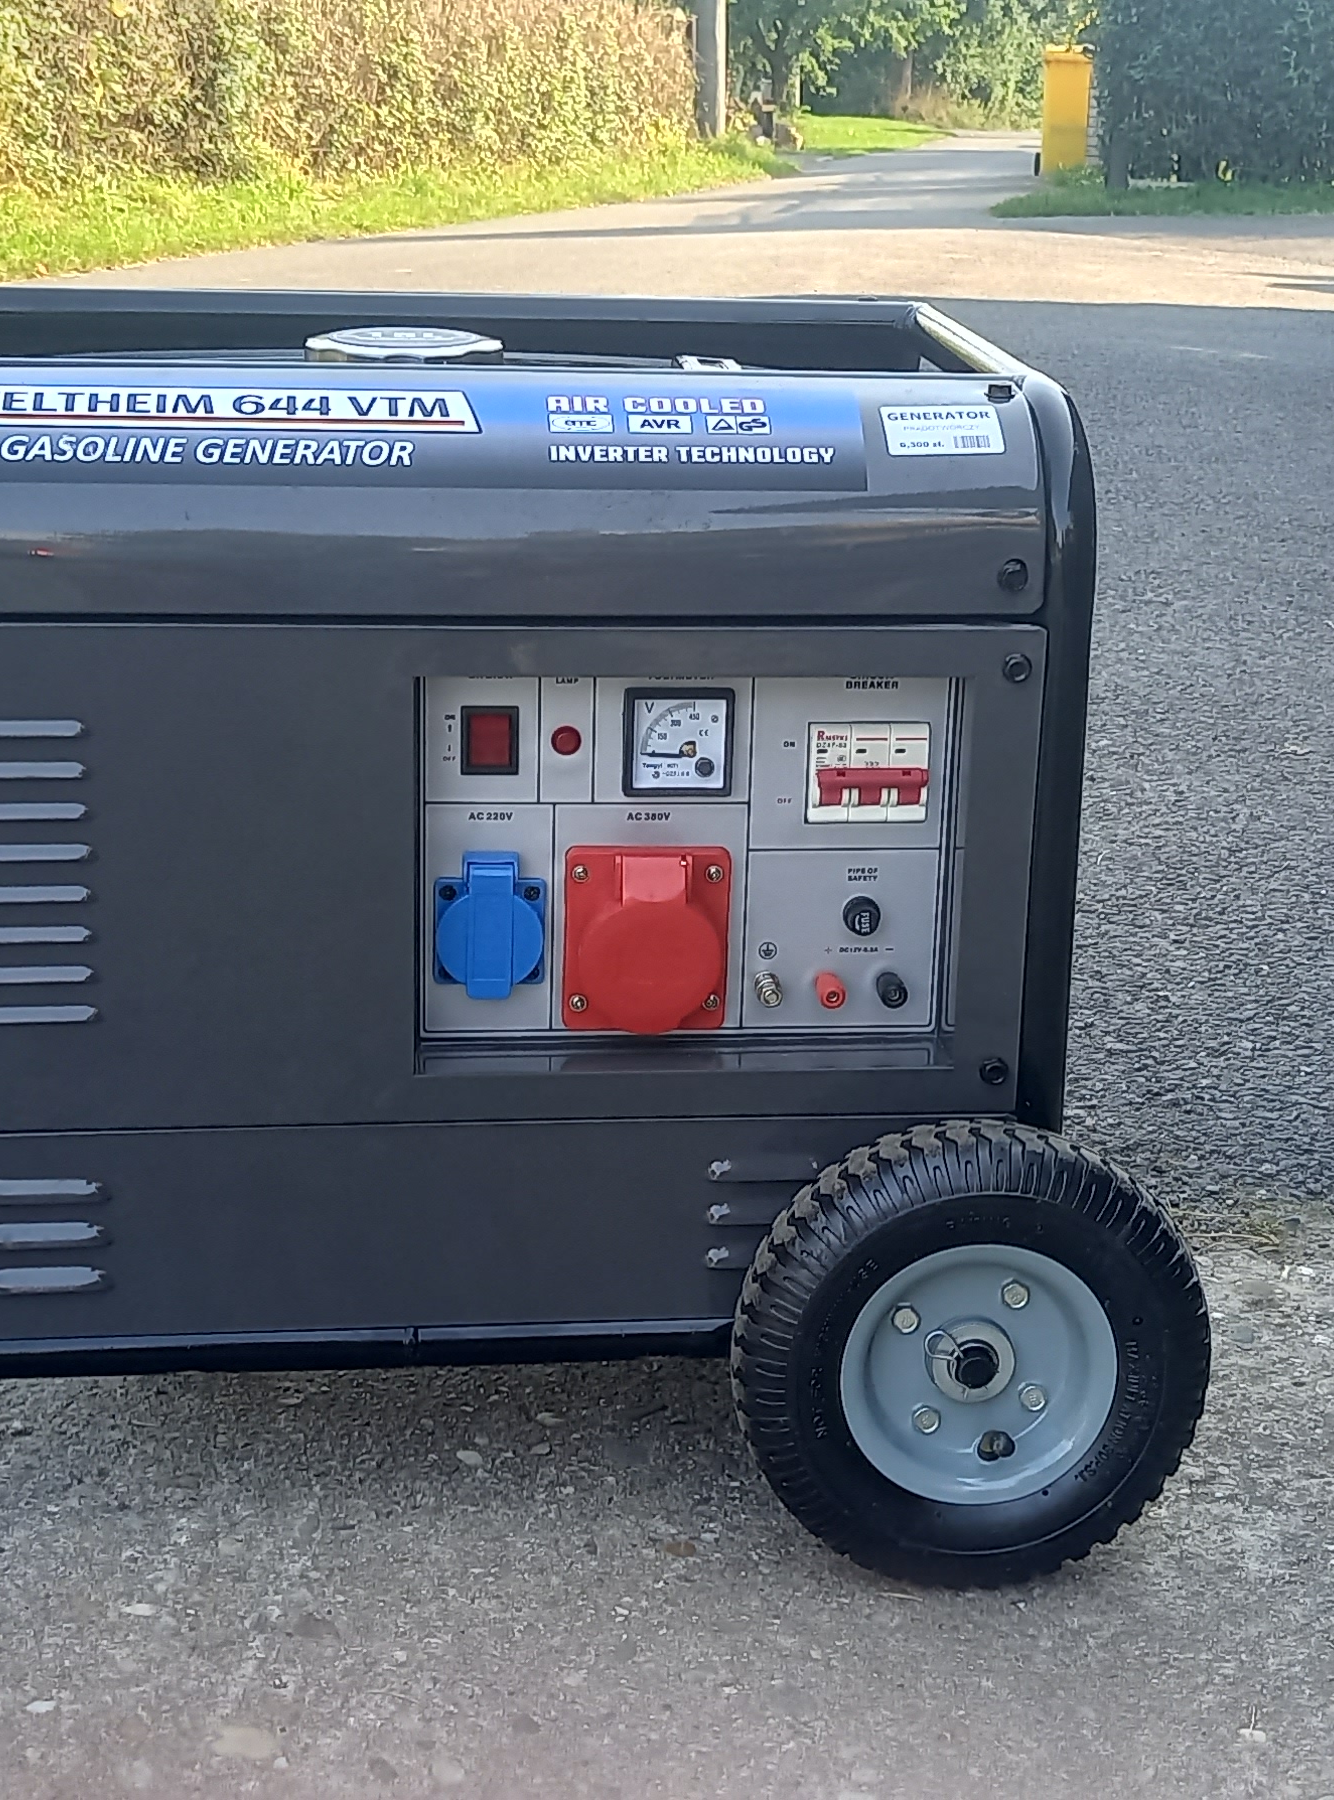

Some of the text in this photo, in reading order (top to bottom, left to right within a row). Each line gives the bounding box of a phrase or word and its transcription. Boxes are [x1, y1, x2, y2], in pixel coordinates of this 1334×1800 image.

[232, 394, 331, 416] 644
[347, 396, 450, 417] VTM
[547, 396, 767, 415] AIR COOLED
[887, 411, 991, 421] GENERATOR
[640, 419, 681, 430] AVR
[193, 438, 415, 467] GENERATOR
[549, 445, 835, 464] INVERTER TECHNOLOGY
[555, 676, 579, 684] LAMP
[845, 680, 899, 690] BREAKER
[645, 702, 654, 714] V
[468, 812, 513, 821] AC 220V
[626, 812, 671, 821] AC 380V
[847, 867, 879, 875] PIPE OF
[860, 912, 871, 934] FUSE
